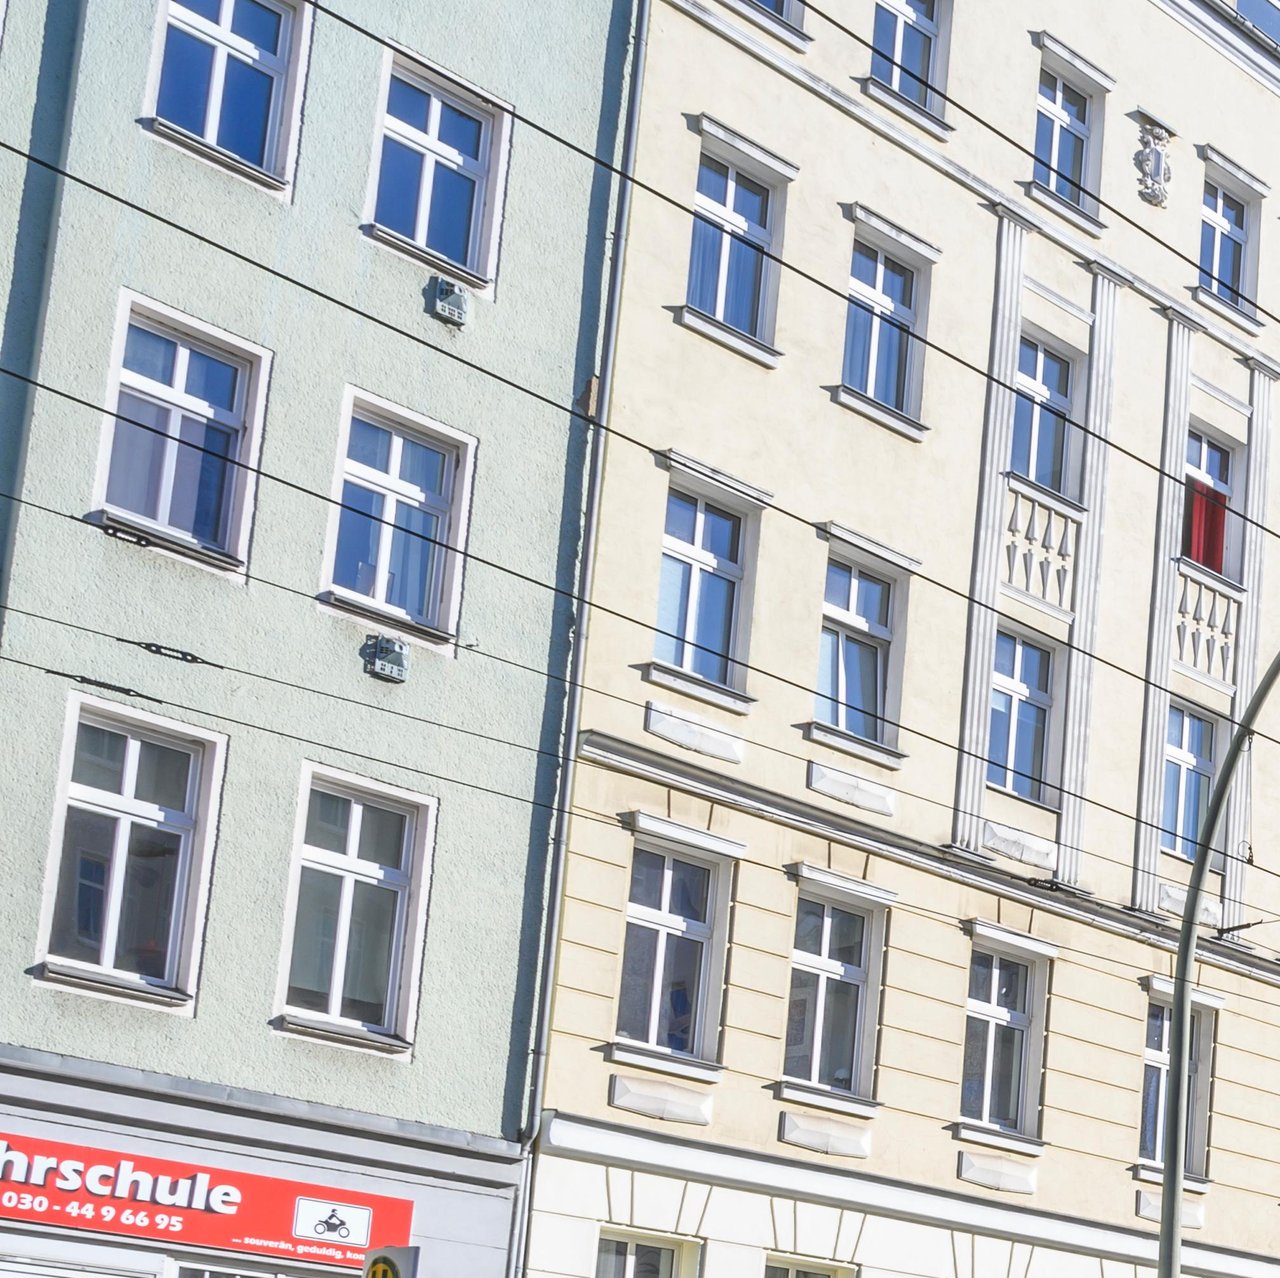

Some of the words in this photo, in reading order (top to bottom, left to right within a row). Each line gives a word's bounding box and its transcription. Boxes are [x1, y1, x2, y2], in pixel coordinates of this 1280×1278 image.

[0, 1140, 242, 1215] hrschule
[2, 1191, 48, 1212] 030
[65, 1201, 95, 1219] 44
[100, 1206, 116, 1222] 9
[120, 1209, 150, 1227] 66
[155, 1214, 184, 1232] 95
[244, 1236, 294, 1251] souverän,
[297, 1244, 344, 1259] geduldig,
